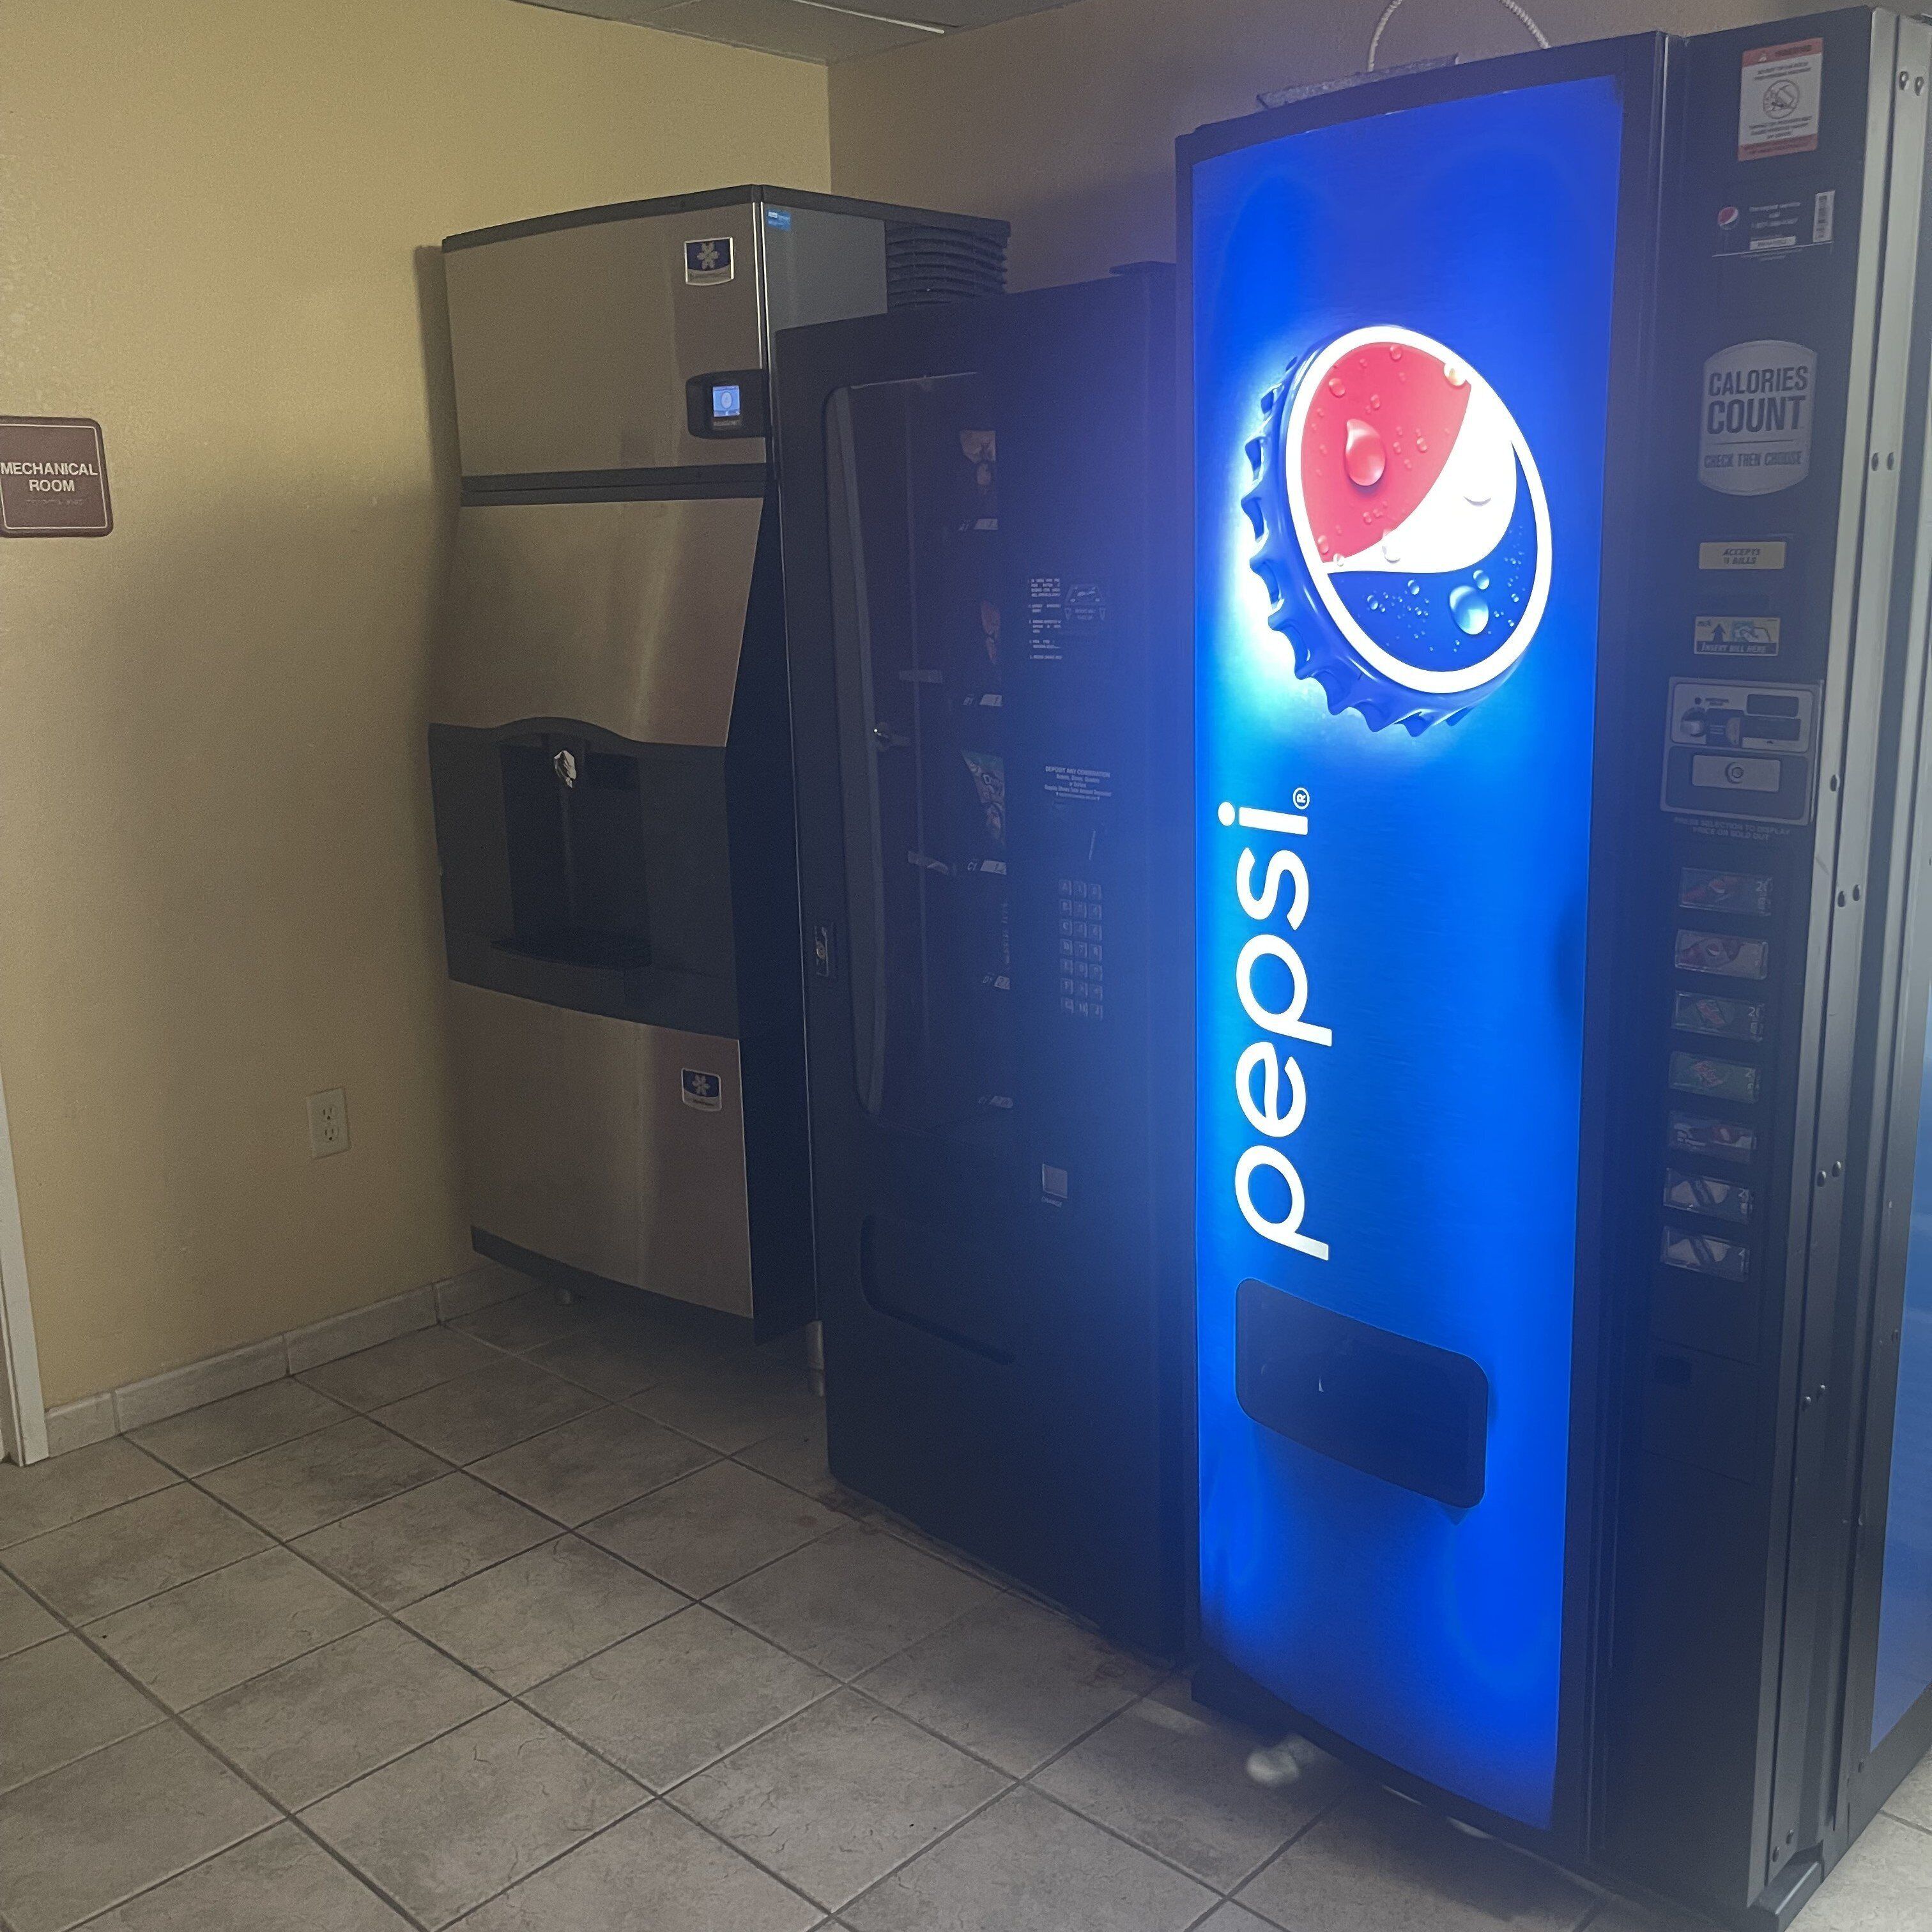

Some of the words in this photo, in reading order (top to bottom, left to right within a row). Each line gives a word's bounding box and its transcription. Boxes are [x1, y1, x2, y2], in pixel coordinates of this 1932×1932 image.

[1708, 365, 1809, 396] CALORIES
[1706, 395, 1805, 434] COUNT
[0, 462, 98, 475] MECHANICAL
[1738, 452, 1761, 466] THEN
[29, 479, 75, 492] ROOM
[1218, 801, 1332, 1261] pepsi
